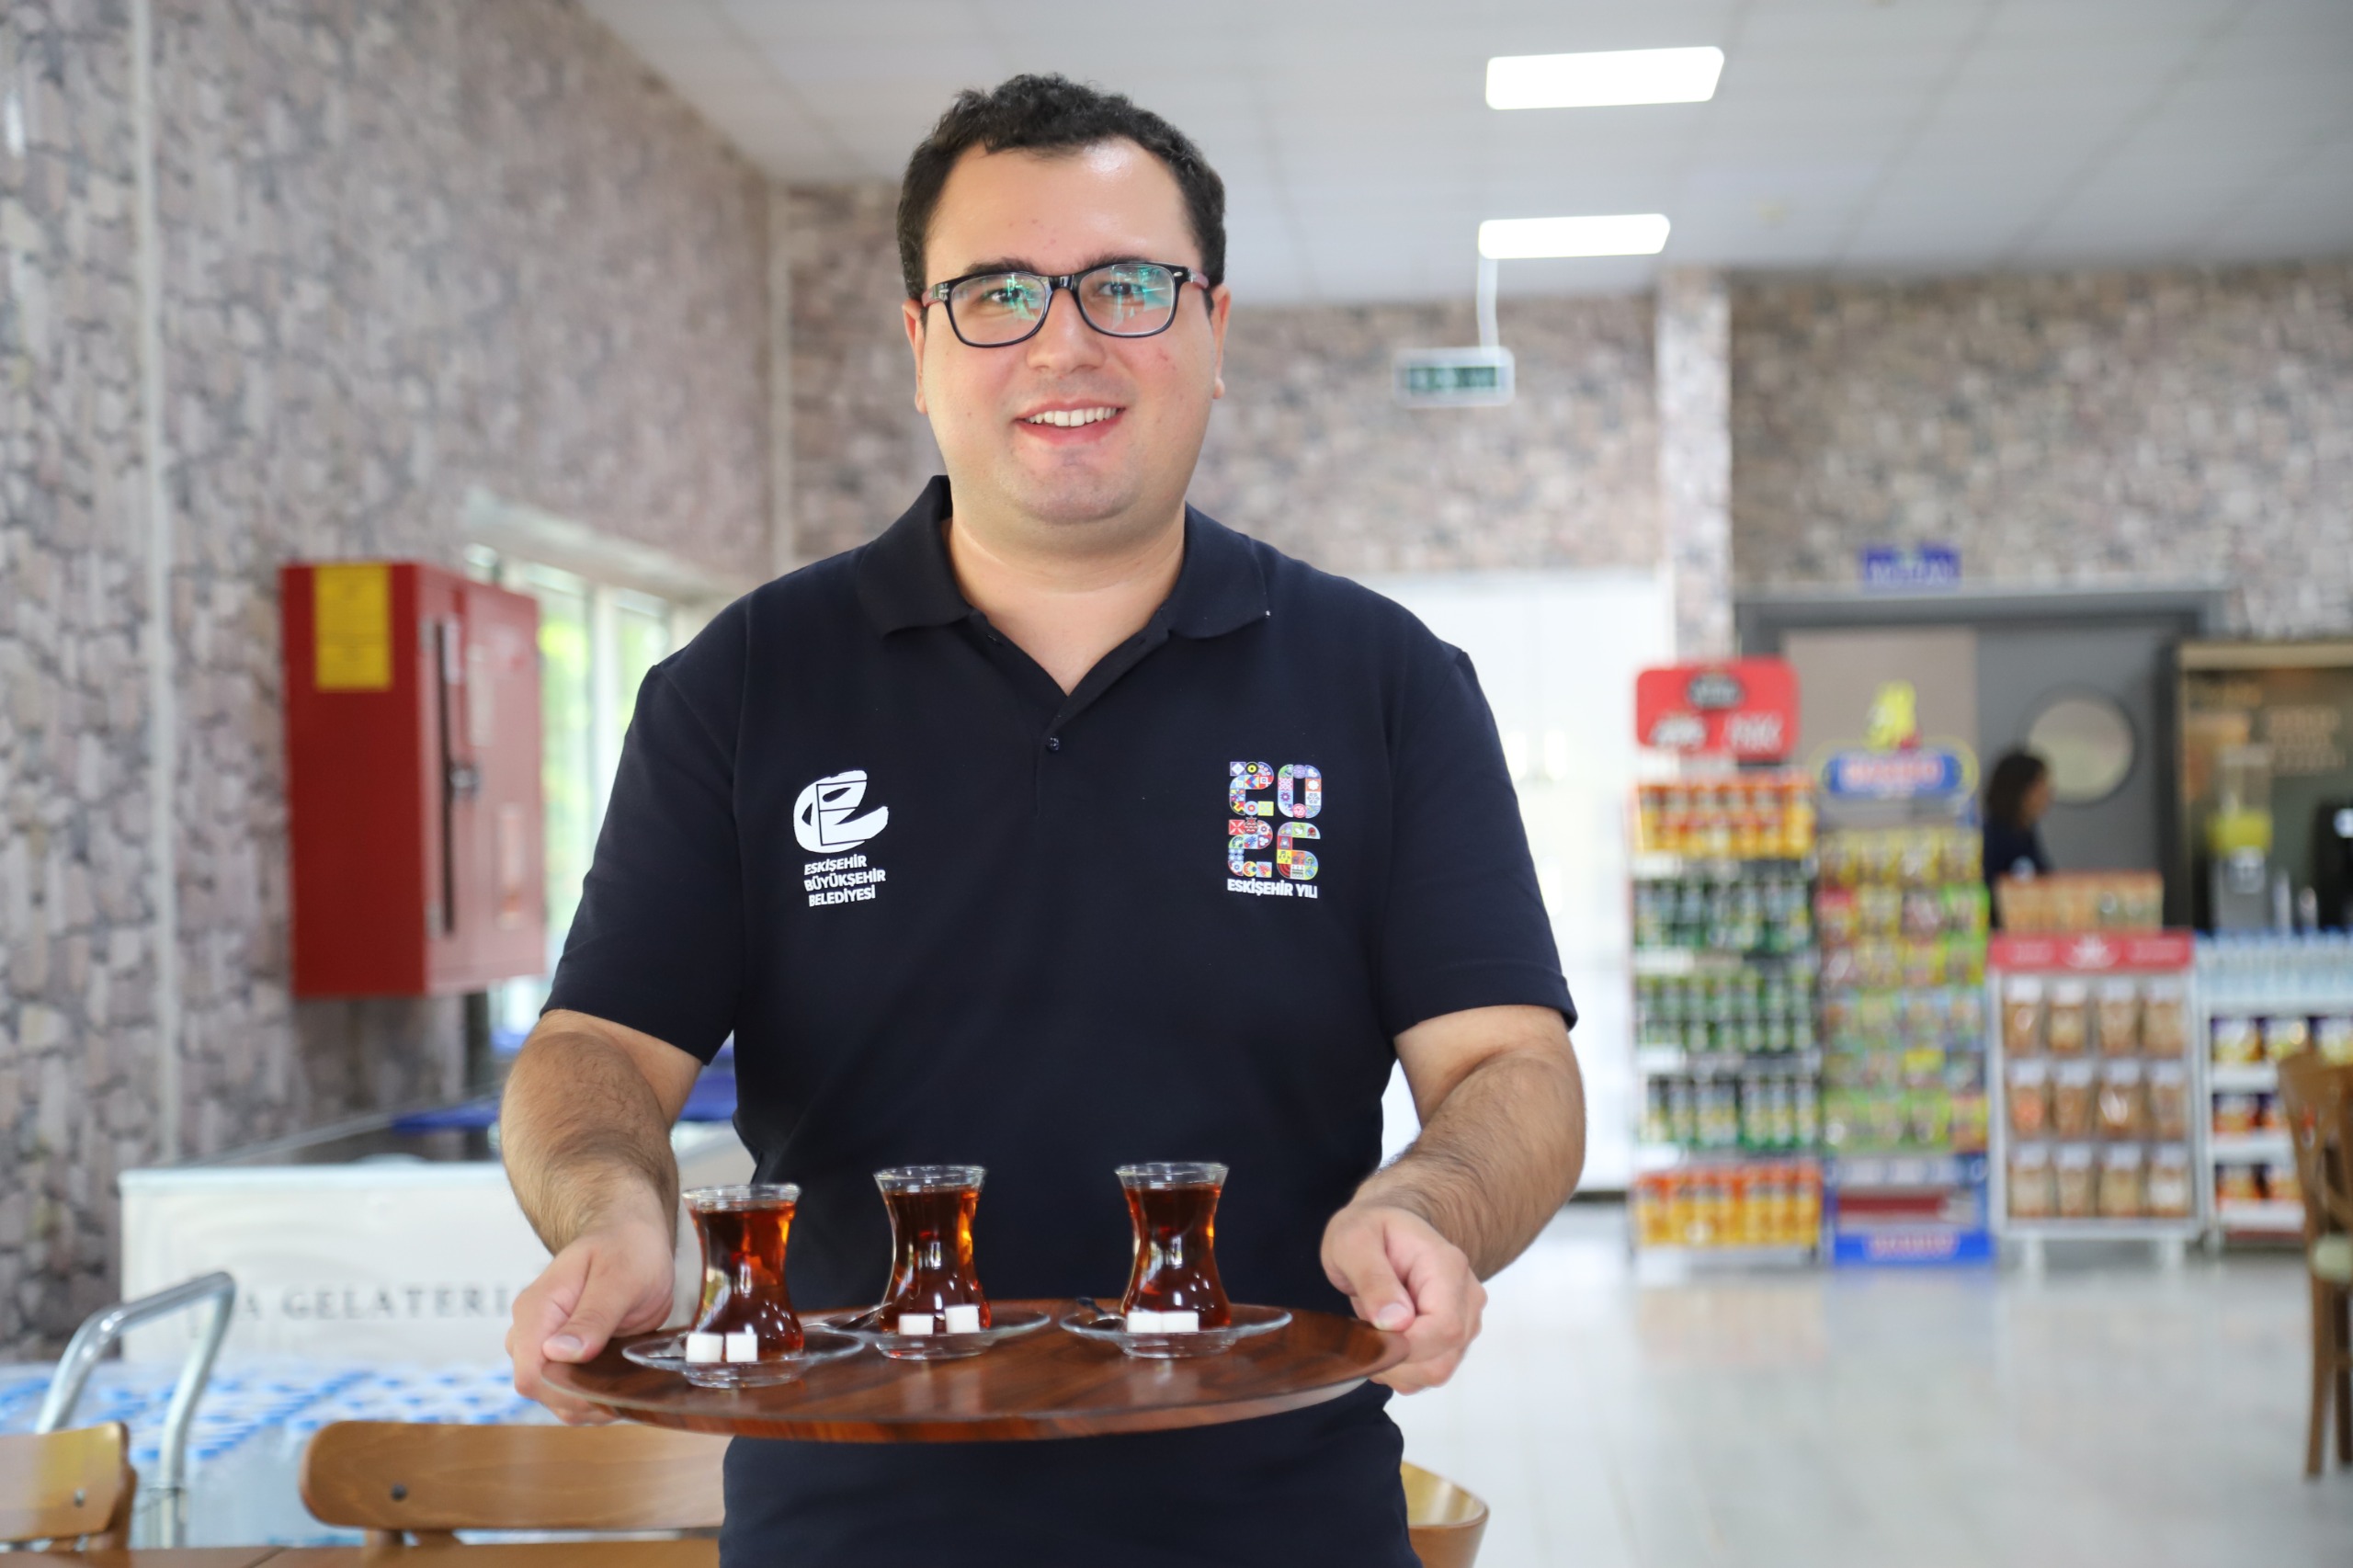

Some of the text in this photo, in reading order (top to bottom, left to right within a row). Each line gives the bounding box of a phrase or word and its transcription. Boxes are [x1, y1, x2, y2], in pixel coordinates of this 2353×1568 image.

[803, 854, 868, 875] ESKİŞEHİR
[803, 868, 886, 892] BÜYÜKŞEHİR
[1227, 878, 1318, 899] ESKİŞEHİR YILI
[808, 884, 876, 907] BELEDİYESİ
[280, 1285, 510, 1321] GELATERI
